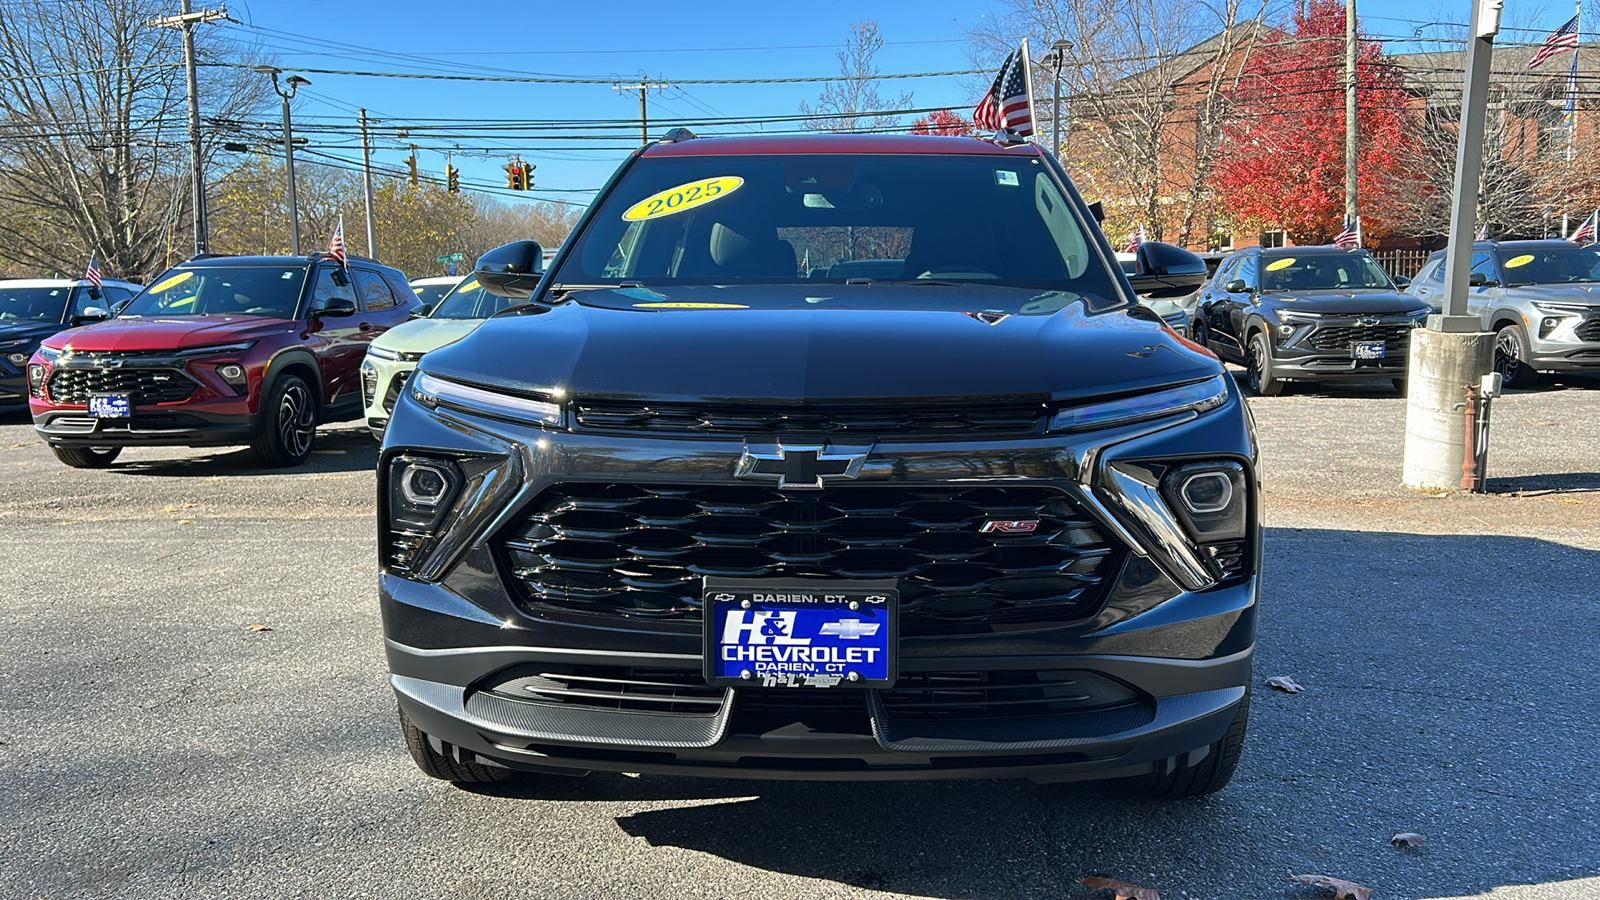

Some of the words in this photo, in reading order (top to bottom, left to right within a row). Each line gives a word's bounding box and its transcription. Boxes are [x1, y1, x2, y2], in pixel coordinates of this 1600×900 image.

[647, 180, 722, 216] 2025
[980, 520, 1039, 533] RS
[753, 593, 818, 603] DARIEN,
[824, 594, 849, 603] CT.
[720, 610, 812, 645] H&L
[721, 645, 881, 663] CHEVROLET
[755, 662, 819, 672] DARIEN,
[825, 663, 846, 672] CT
